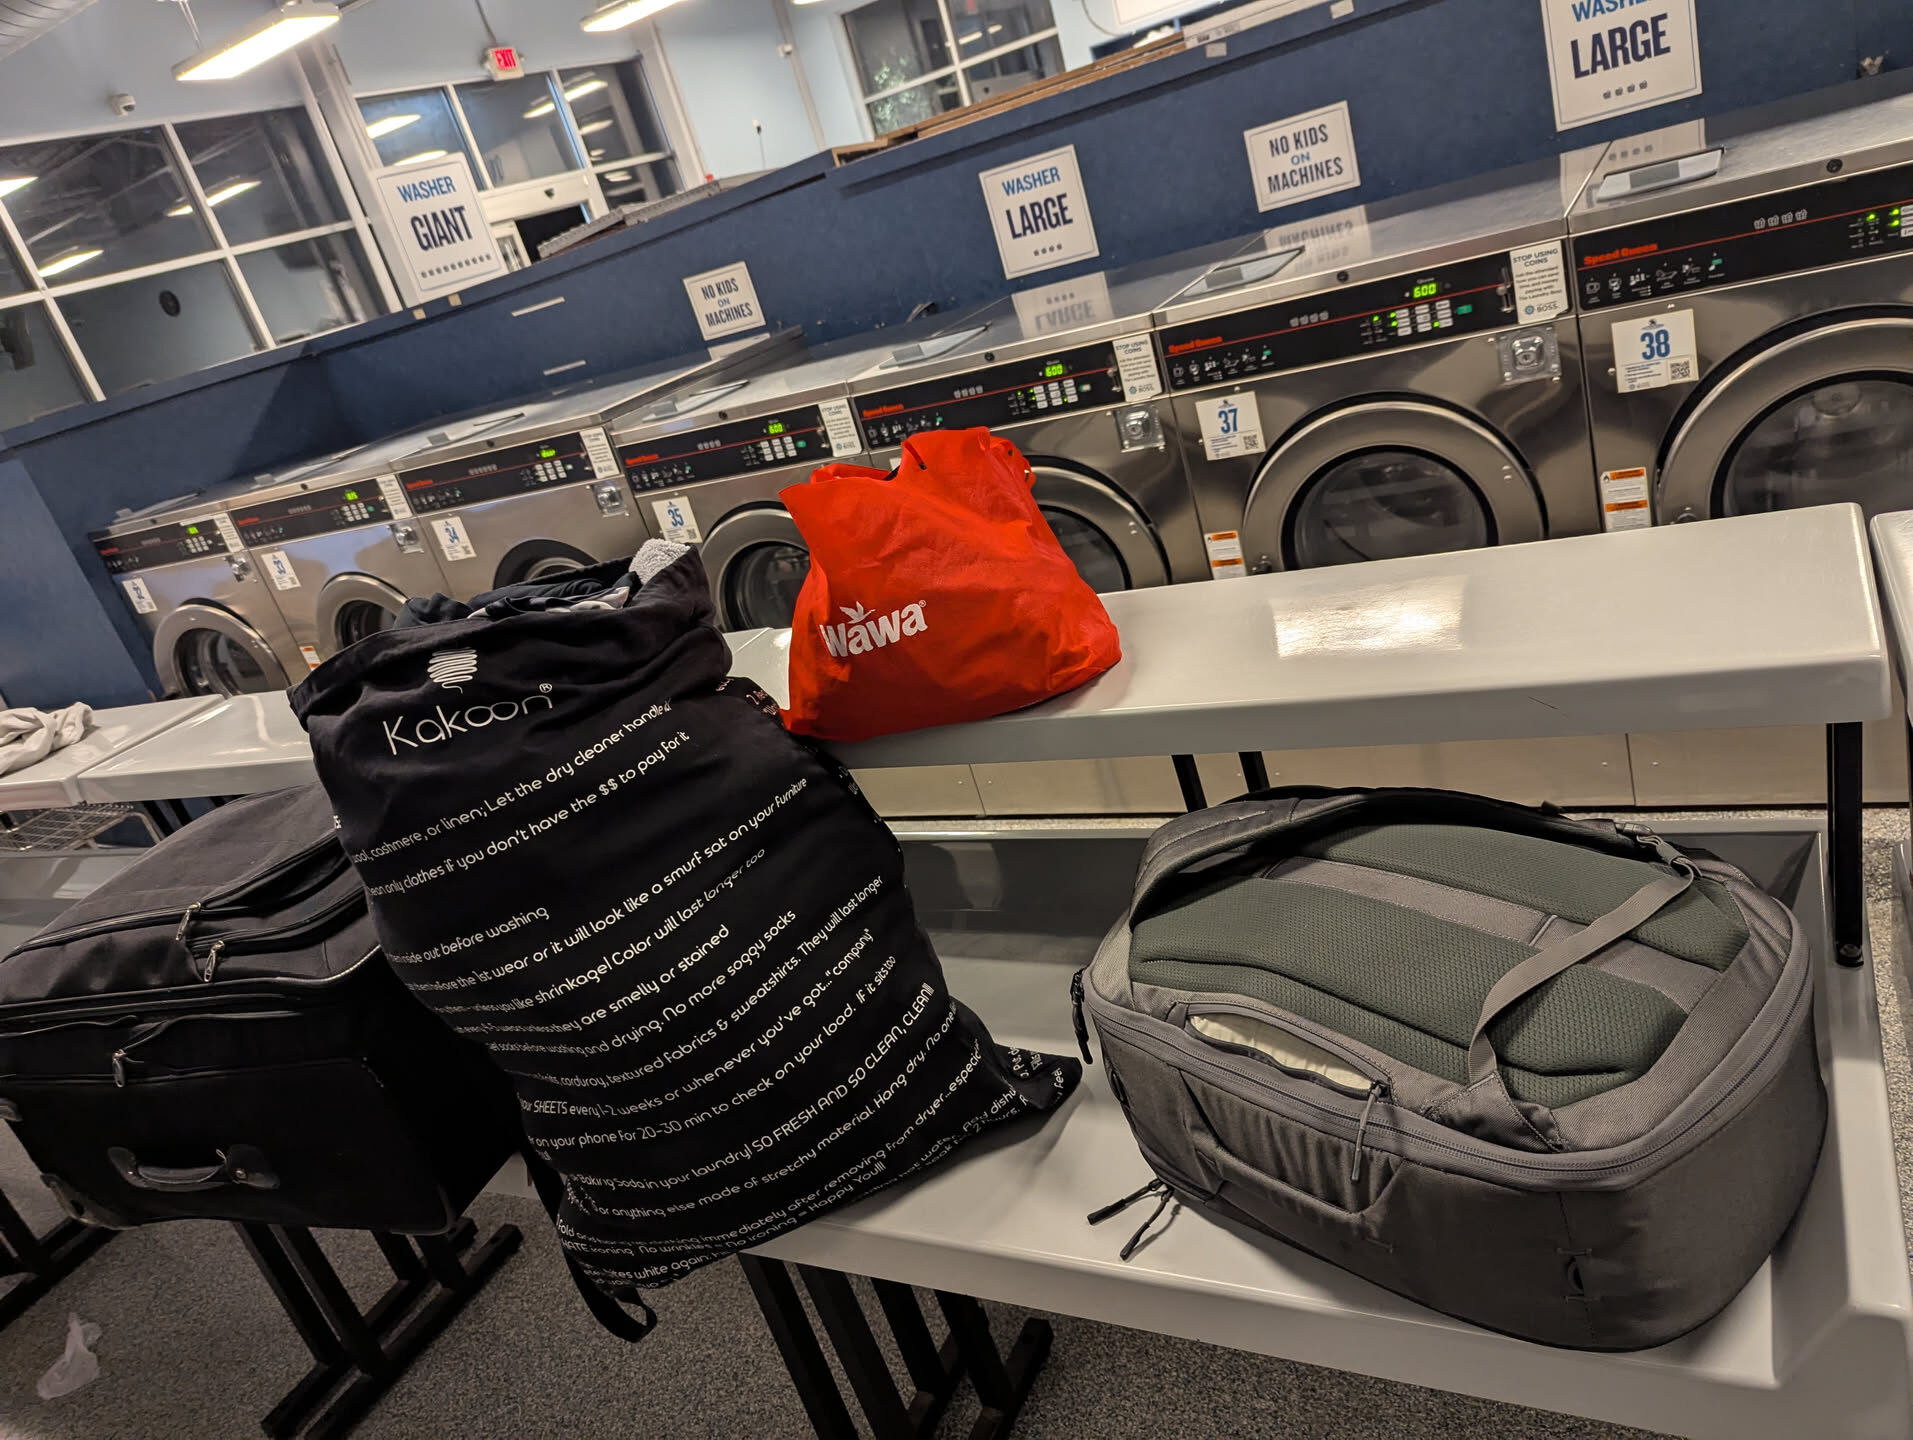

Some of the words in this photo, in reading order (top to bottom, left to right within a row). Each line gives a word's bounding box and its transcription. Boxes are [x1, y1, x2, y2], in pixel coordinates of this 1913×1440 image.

[493, 48, 517, 70] EXIT
[1570, 13, 1671, 79] LARGE
[1269, 135, 1290, 158] NO
[1293, 123, 1329, 151] KIDS
[1290, 152, 1311, 166] ON
[396, 175, 456, 203] WASHER
[1002, 166, 1061, 197] WASHER
[1267, 156, 1344, 194] MACHINES
[410, 205, 473, 251] GIANT
[1005, 193, 1073, 240] LARGE
[1513, 254, 1532, 263] STOP
[1534, 249, 1558, 259] USING
[1524, 257, 1549, 267] COINS
[1584, 249, 1620, 265] Speed
[1621, 243, 1658, 256] Queen
[701, 284, 716, 300] NO
[715, 277, 739, 296] KIDS
[717, 297, 730, 307] ON
[705, 302, 753, 327] MACHINES
[1640, 329, 1670, 360] 38
[1218, 408, 1238, 434] 37
[668, 508, 684, 527] 35
[371, 833, 428, 860] cashmere,
[427, 825, 441, 835] or
[440, 800, 487, 829] linen;
[484, 792, 515, 811] Let
[514, 780, 542, 797] the
[546, 763, 574, 782] dry
[575, 730, 624, 765] cleaner
[623, 705, 667, 731] handle
[386, 880, 405, 893] only
[404, 866, 445, 888] clothes
[446, 859, 454, 872] if
[457, 851, 484, 870] you
[487, 831, 529, 855] don't
[529, 810, 568, 835] have
[570, 794, 597, 812] the
[599, 779, 618, 795] $$
[619, 770, 635, 783] to
[638, 750, 665, 775] pay
[661, 737, 680, 752] for
[680, 732, 689, 741] it
[457, 973, 477, 987] the
[492, 957, 527, 977] wear
[533, 948, 547, 961] or
[550, 942, 563, 953] it
[564, 926, 591, 946] will
[590, 909, 624, 932] look
[623, 893, 648, 912] like
[652, 884, 663, 894] a
[664, 852, 701, 886] smurf
[705, 838, 727, 857] sat
[729, 825, 748, 840] on
[749, 803, 774, 828] your
[775, 779, 806, 807] furniture
[424, 948, 441, 960] out
[441, 934, 483, 954] before
[486, 908, 549, 937] washing
[514, 999, 534, 1009] like
[612, 936, 651, 965] Color
[654, 916, 679, 939] will
[677, 899, 703, 921] last
[704, 868, 742, 901] longer
[747, 849, 764, 867] too
[550, 1021, 582, 1032] they
[581, 1009, 606, 1024] are
[609, 981, 660, 1012] smelly
[660, 968, 675, 983] or
[678, 925, 728, 971] stained
[561, 1075, 610, 1088] corduroy,
[608, 1057, 664, 1083] textured
[664, 1029, 716, 1063] fabrics
[717, 1019, 727, 1030] &
[731, 957, 801, 1021] sweatshirts.
[798, 926, 828, 955] They
[825, 912, 842, 931] will
[839, 899, 857, 916] last
[855, 876, 882, 902] longer
[586, 1040, 609, 1054] and
[612, 1020, 664, 1047] drying.
[663, 1004, 686, 1020] No
[689, 975, 725, 1005] more
[728, 940, 766, 976] soggy
[764, 911, 795, 942] socks
[534, 1100, 567, 1114] SHEETS
[570, 1104, 602, 1118] every
[617, 1098, 663, 1114] weeks
[665, 1090, 679, 1100] or
[682, 1043, 755, 1092] whenever
[758, 1006, 801, 1046] you've
[550, 1137, 575, 1149] your
[579, 1133, 617, 1148] phone
[618, 1130, 635, 1141] for
[637, 1121, 682, 1139] 20-30
[685, 1112, 712, 1128] min
[712, 1104, 728, 1114] to
[732, 1078, 773, 1104] check
[775, 1062, 794, 1079] on
[794, 1034, 822, 1063] your
[823, 1004, 856, 1036] load.
[856, 990, 865, 1003] If
[865, 983, 875, 994] it
[875, 968, 888, 985] sits
[612, 1208, 666, 1219] anything
[667, 1203, 695, 1212] else
[699, 1186, 740, 1205] made
[744, 1177, 758, 1188] of
[762, 1149, 816, 1183] stretchy
[818, 1106, 875, 1150] material.
[874, 1074, 907, 1108] Hang
[907, 1051, 925, 1073] dry.
[926, 1033, 940, 1050] No
[942, 1012, 953, 1032] one
[618, 1177, 645, 1189] Soda
[644, 1179, 659, 1188] in
[659, 1174, 689, 1189] your
[752, 1136, 773, 1151] SO
[773, 1105, 818, 1141] FRESH
[818, 1085, 847, 1110] AND
[848, 1067, 865, 1088] SO
[865, 1028, 906, 1069] CLEAN,
[696, 1210, 786, 1248] immediately
[788, 1190, 824, 1211] after
[825, 1150, 886, 1191] removing
[886, 1126, 914, 1151] from
[638, 1243, 657, 1253] No
[749, 1215, 797, 1241] ironing
[806, 1185, 853, 1211] Happy
[634, 1266, 668, 1279] white
[671, 1256, 714, 1270] again.
